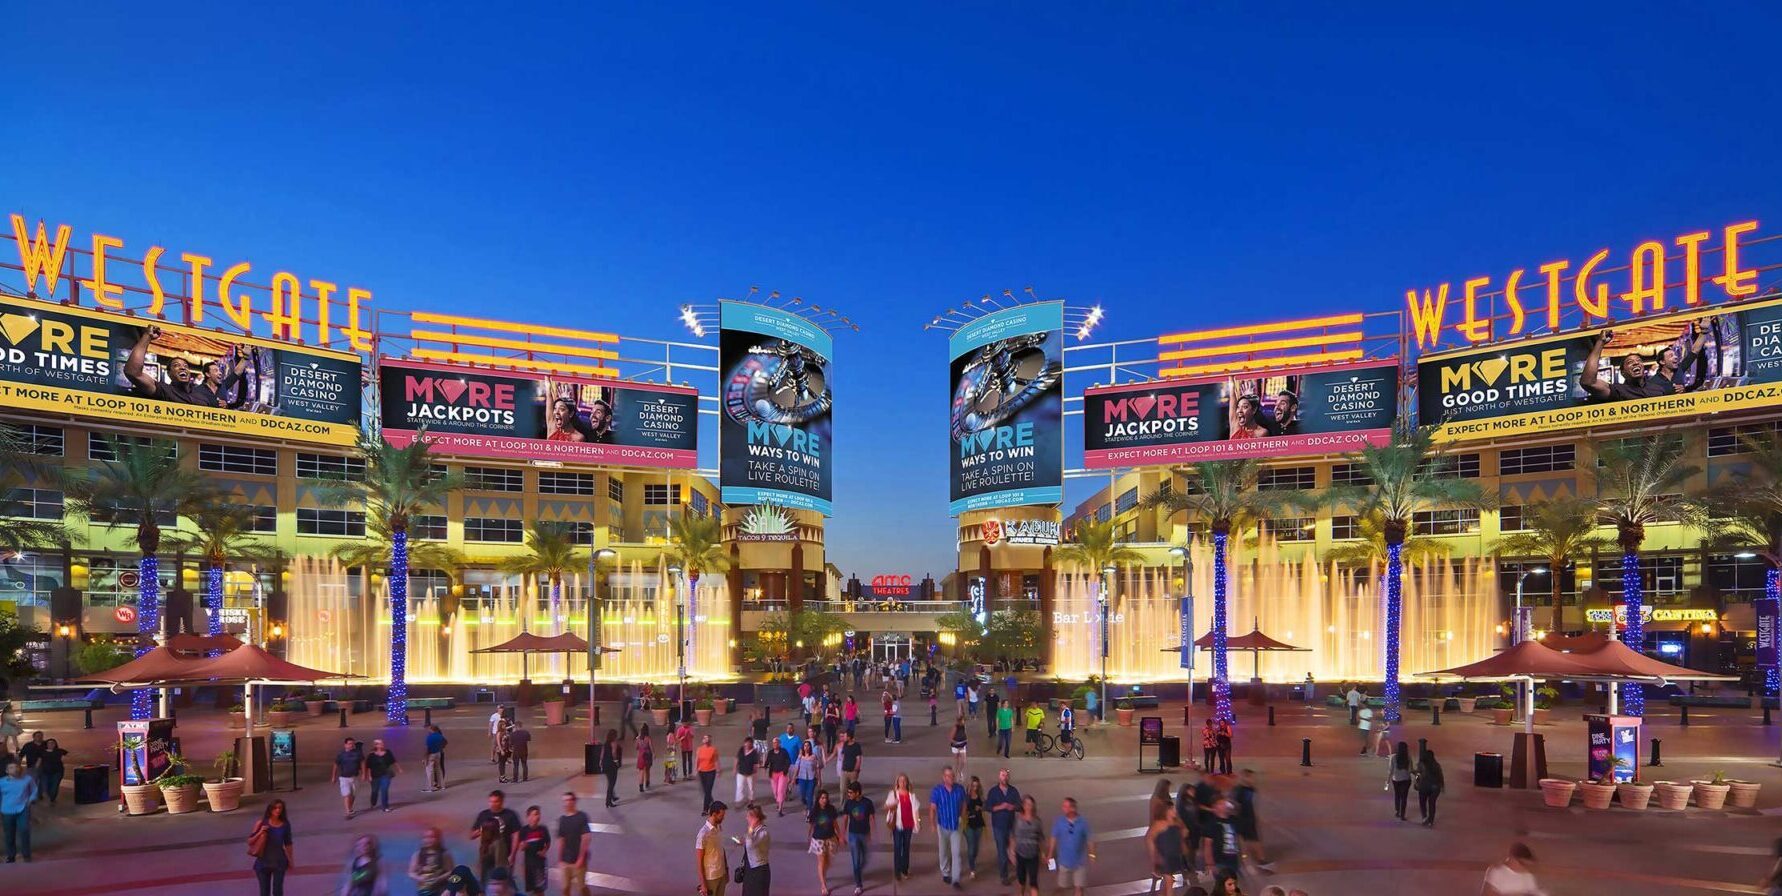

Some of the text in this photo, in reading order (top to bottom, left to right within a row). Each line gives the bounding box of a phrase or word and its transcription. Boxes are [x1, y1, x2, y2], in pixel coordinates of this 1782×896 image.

[10, 213, 373, 352] WESTGATE
[1407, 220, 1758, 350] WESTGATE
[982, 322, 1004, 333] DIAMOND
[34, 352, 110, 376] TIMES
[25, 367, 40, 375] OF
[45, 370, 109, 385] WESTGATE!
[284, 376, 342, 392] DIAMOND
[291, 367, 337, 382] DESERT
[290, 386, 336, 400] CASINO
[1328, 391, 1380, 402] DIAMOND
[1334, 382, 1376, 394] DESERT
[1442, 379, 1568, 408] GOOD TIMES
[16, 388, 59, 401] MORE
[64, 394, 82, 404] AT
[88, 397, 126, 409] LOOP
[130, 402, 150, 412] 101
[154, 406, 162, 414] &
[166, 407, 236, 423] NORTHERN
[240, 417, 258, 425] AND
[260, 419, 330, 434] DDCAZ.COM
[288, 399, 309, 407] WEST
[312, 402, 340, 411] VALLEY
[407, 403, 514, 424] JACKPOTS
[644, 404, 679, 414] DESERT
[1333, 400, 1374, 411] CASINO
[1443, 407, 1462, 416] JUST
[1466, 403, 1496, 413] NORTH
[1514, 394, 1567, 406] WESTGATE!
[1447, 388, 1782, 435] EXPECT MORE AT LOOP 101 & NORTHERN AND DDCAZ.
[640, 412, 684, 422] DIAMOND
[644, 420, 679, 430] CASINO
[1105, 416, 1198, 437] JACKPOTS
[454, 438, 482, 447] MORE
[500, 441, 527, 450] LOOP
[530, 443, 543, 451] 101
[554, 444, 604, 455] NORTHERN
[622, 450, 674, 460] DDCAZ.COM
[748, 444, 820, 468] WAYS TO WIN
[1108, 450, 1140, 460] EXPECT
[1143, 448, 1168, 457] MORE
[1171, 447, 1182, 455] AT
[1185, 446, 1210, 454] LOOP
[1212, 444, 1226, 452] 101
[1236, 440, 1288, 450] NORTHERN
[1308, 434, 1368, 446] DDCAZ.COM
[962, 446, 1034, 468] WAYS TO WIN
[748, 460, 820, 481] TAKE A SPIN ON
[962, 462, 1034, 482] TAKE A SPIN ON
[748, 471, 820, 490] LIVE ROULETTE!
[962, 472, 1034, 491] LIVE ROULETTE!
[873, 586, 910, 595] THEATRES
[1052, 612, 1080, 624] Bar
[1758, 616, 1770, 648] WESTGATE
